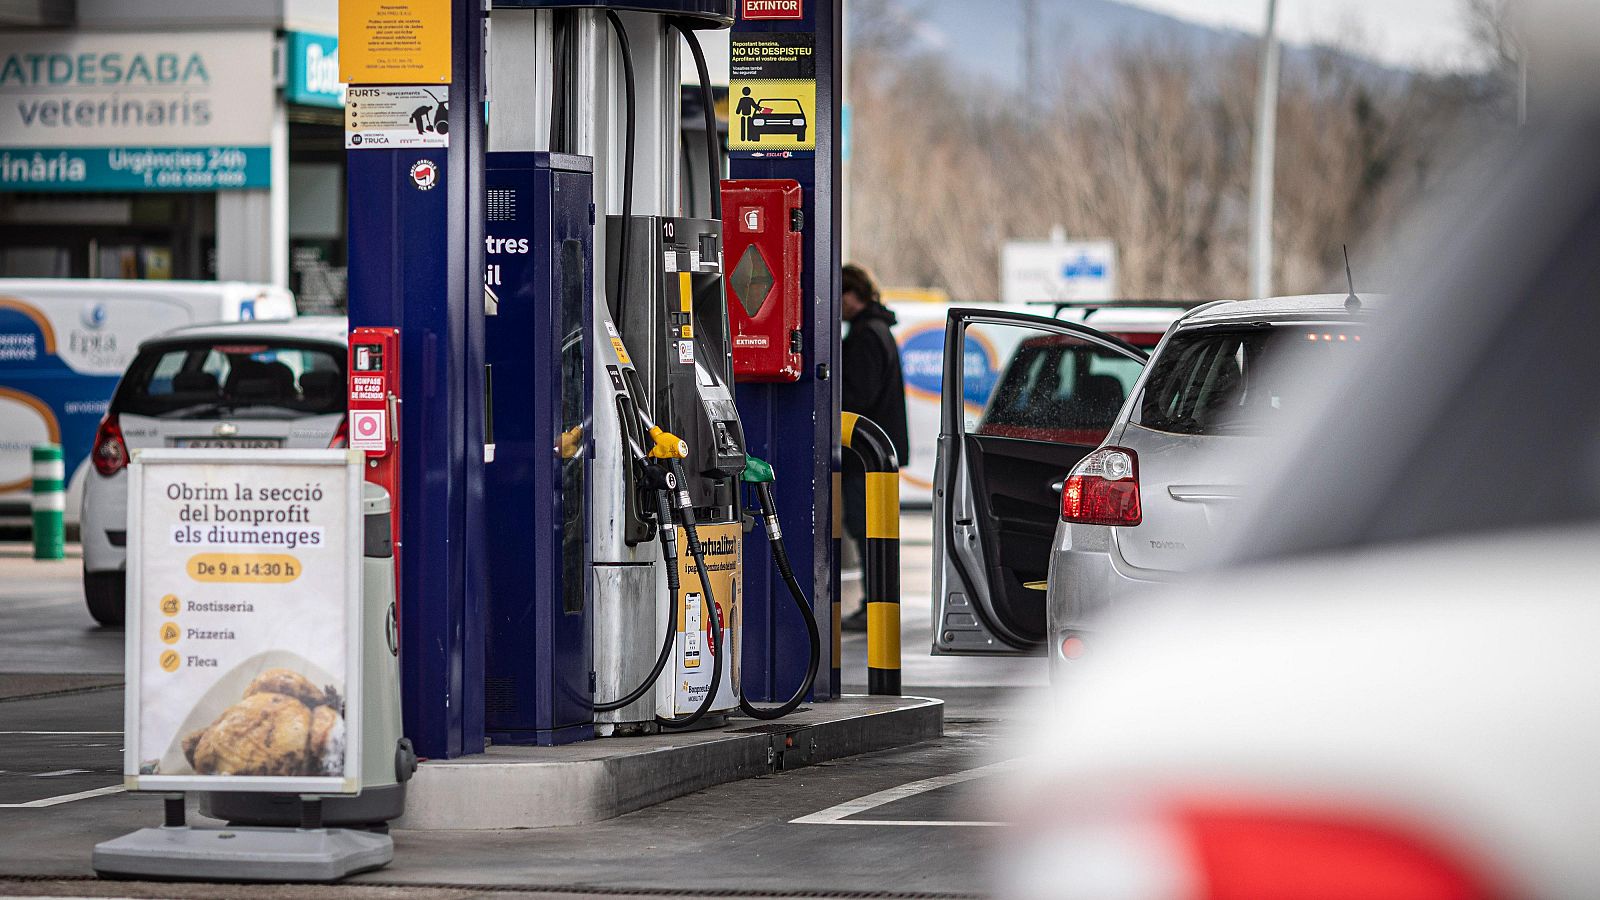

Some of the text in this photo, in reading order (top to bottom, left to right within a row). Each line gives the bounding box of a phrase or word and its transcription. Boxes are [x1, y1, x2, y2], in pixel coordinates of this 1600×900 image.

[747, 1, 798, 11] EXTINTOR
[732, 48, 812, 56] NO US DESPISTEU
[349, 89, 380, 97] FURTS
[18, 91, 211, 127] veterinaris
[108, 150, 206, 174] Urgències
[664, 222, 674, 238] 10
[485, 235, 529, 254] tres
[484, 264, 502, 286] il
[167, 483, 323, 501] Obrim la secció
[179, 504, 310, 526] del bonprofit
[175, 526, 320, 548] els diumenges
[197, 562, 294, 576] De 9 a 14:30 h
[187, 601, 254, 613] Rostisseria
[187, 628, 236, 641] Pizzeria
[187, 656, 218, 668] Fleca
